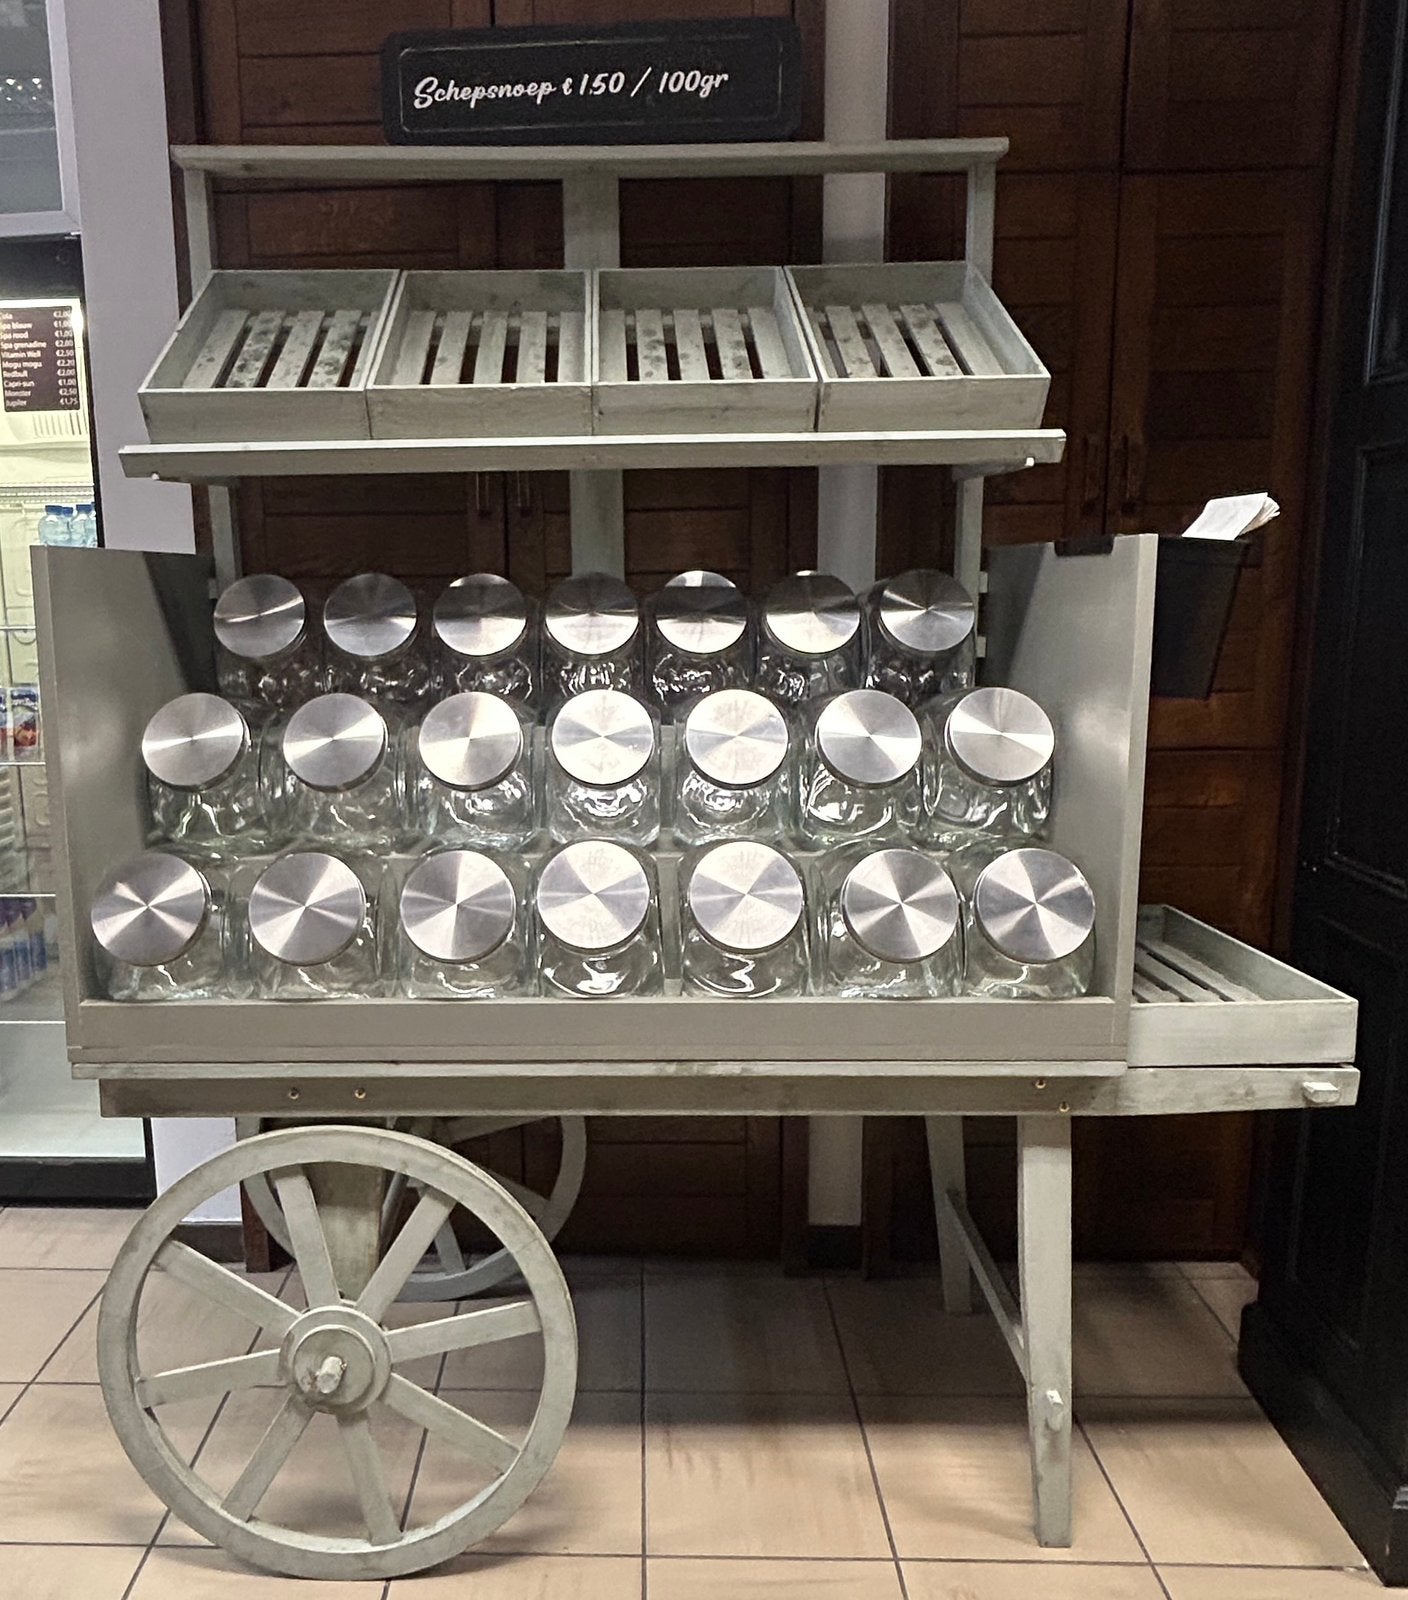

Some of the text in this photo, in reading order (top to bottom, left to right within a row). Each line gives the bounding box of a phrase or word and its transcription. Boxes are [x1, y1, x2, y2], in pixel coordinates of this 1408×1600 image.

[413, 66, 729, 110] Schepsnoep € 1.50 / 100gr
[11, 321, 33, 330] blauw
[12, 330, 29, 339] rood
[0, 341, 13, 351] Spa
[13, 340, 47, 351] grenadine
[0, 350, 26, 359] Vitamin
[2, 361, 22, 370] Mogu
[22, 361, 42, 370] mogu
[4, 389, 31, 397] Monster
